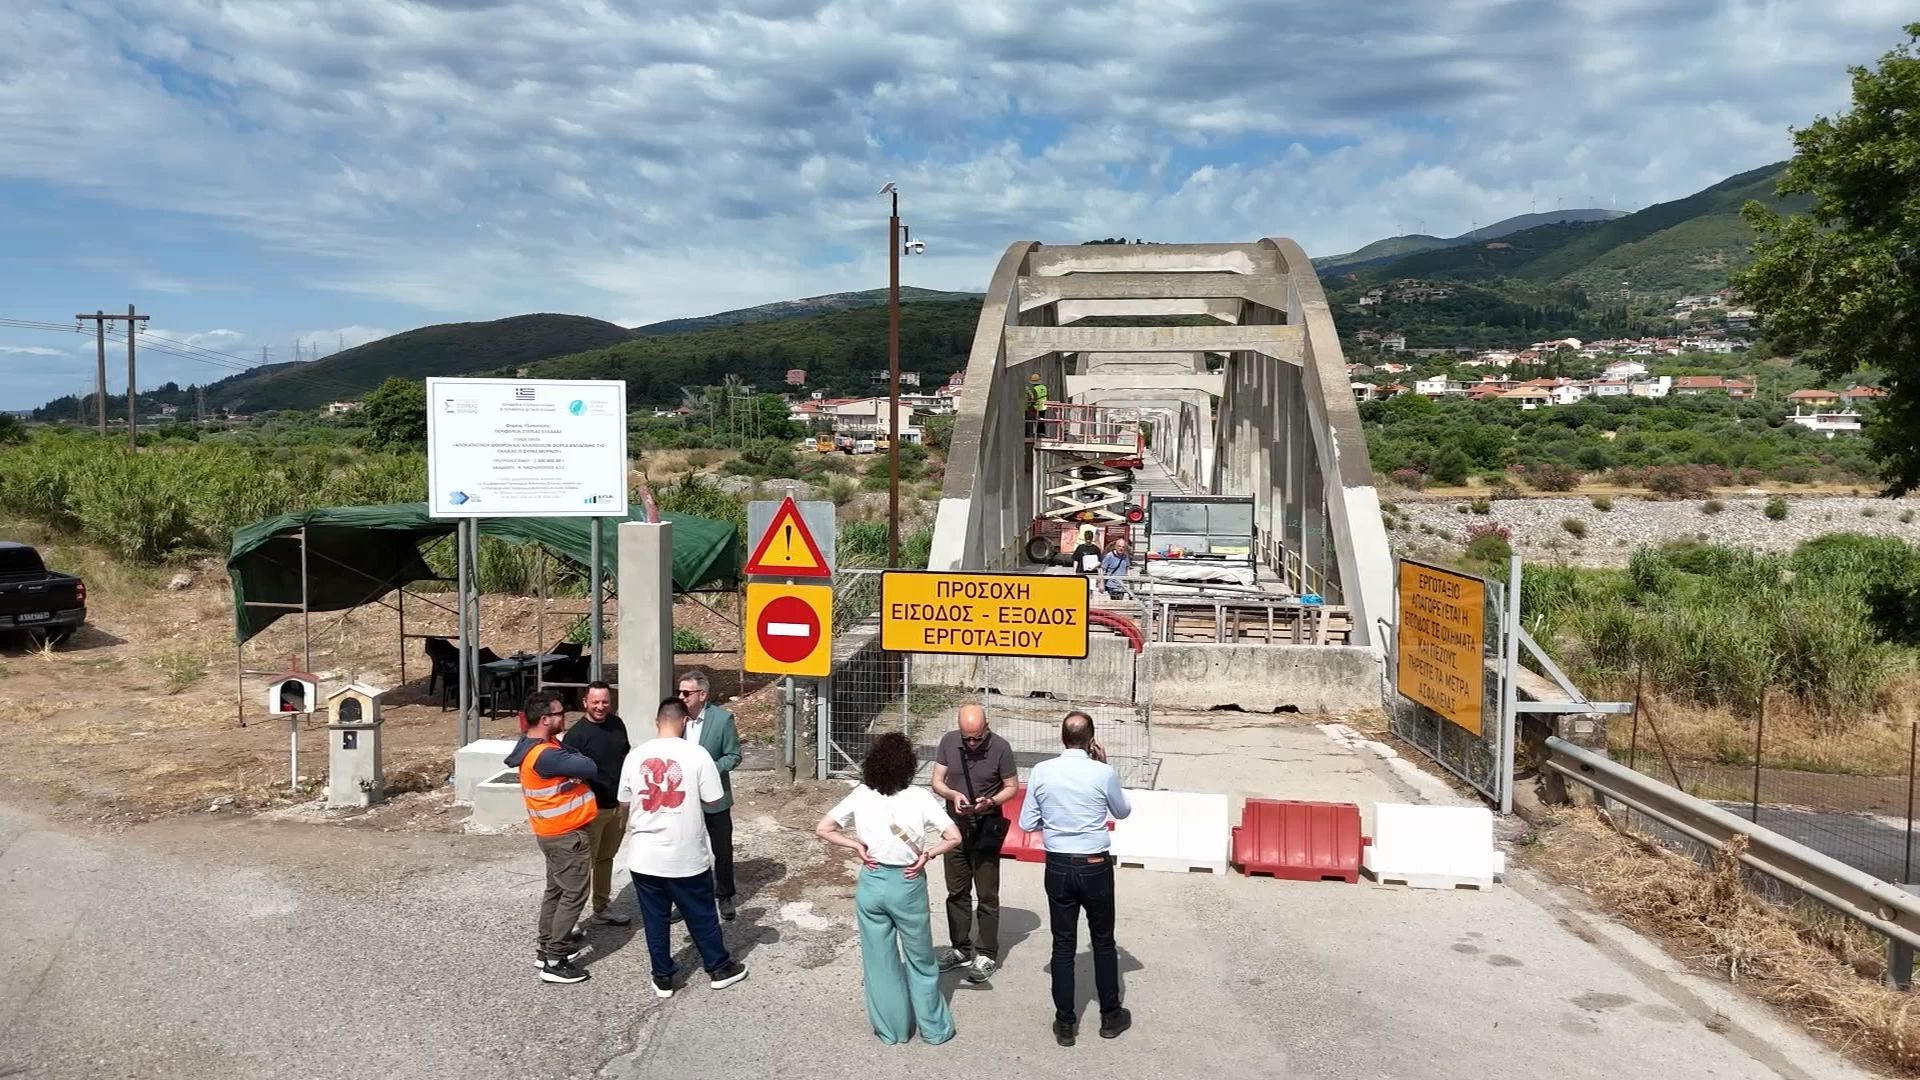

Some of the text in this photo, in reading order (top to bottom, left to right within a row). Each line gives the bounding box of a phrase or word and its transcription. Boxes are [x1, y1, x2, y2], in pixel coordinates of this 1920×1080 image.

[936, 581, 1030, 600] ΠΡΟΣΟΧΗ
[1419, 573, 1460, 600] ΕΡΓΟΤΑΞΙΟ
[891, 603, 973, 622] ΕΙΣΟΔΟΣ
[998, 606, 1077, 626] ΕΞΟΔΟΣ
[1412, 592, 1469, 627] ΑΠΑΓΟΡΕΥΕΤΑΙ Η
[924, 628, 1043, 649] ΕΡΓΟΤΑΞΙΟΥ
[1431, 621, 1440, 639] ΣΕ
[1441, 625, 1476, 654] ΟΧΗΜΑΤΑ
[1430, 642, 1458, 670] ΠΕΖΟΥΣ
[1408, 653, 1471, 699] ΤΗΡΕΙΤΕ ΤΑ ΜΕΤΡΑ
[1418, 682, 1457, 715] ΑΣΦΑΛΕΙΑΣ
